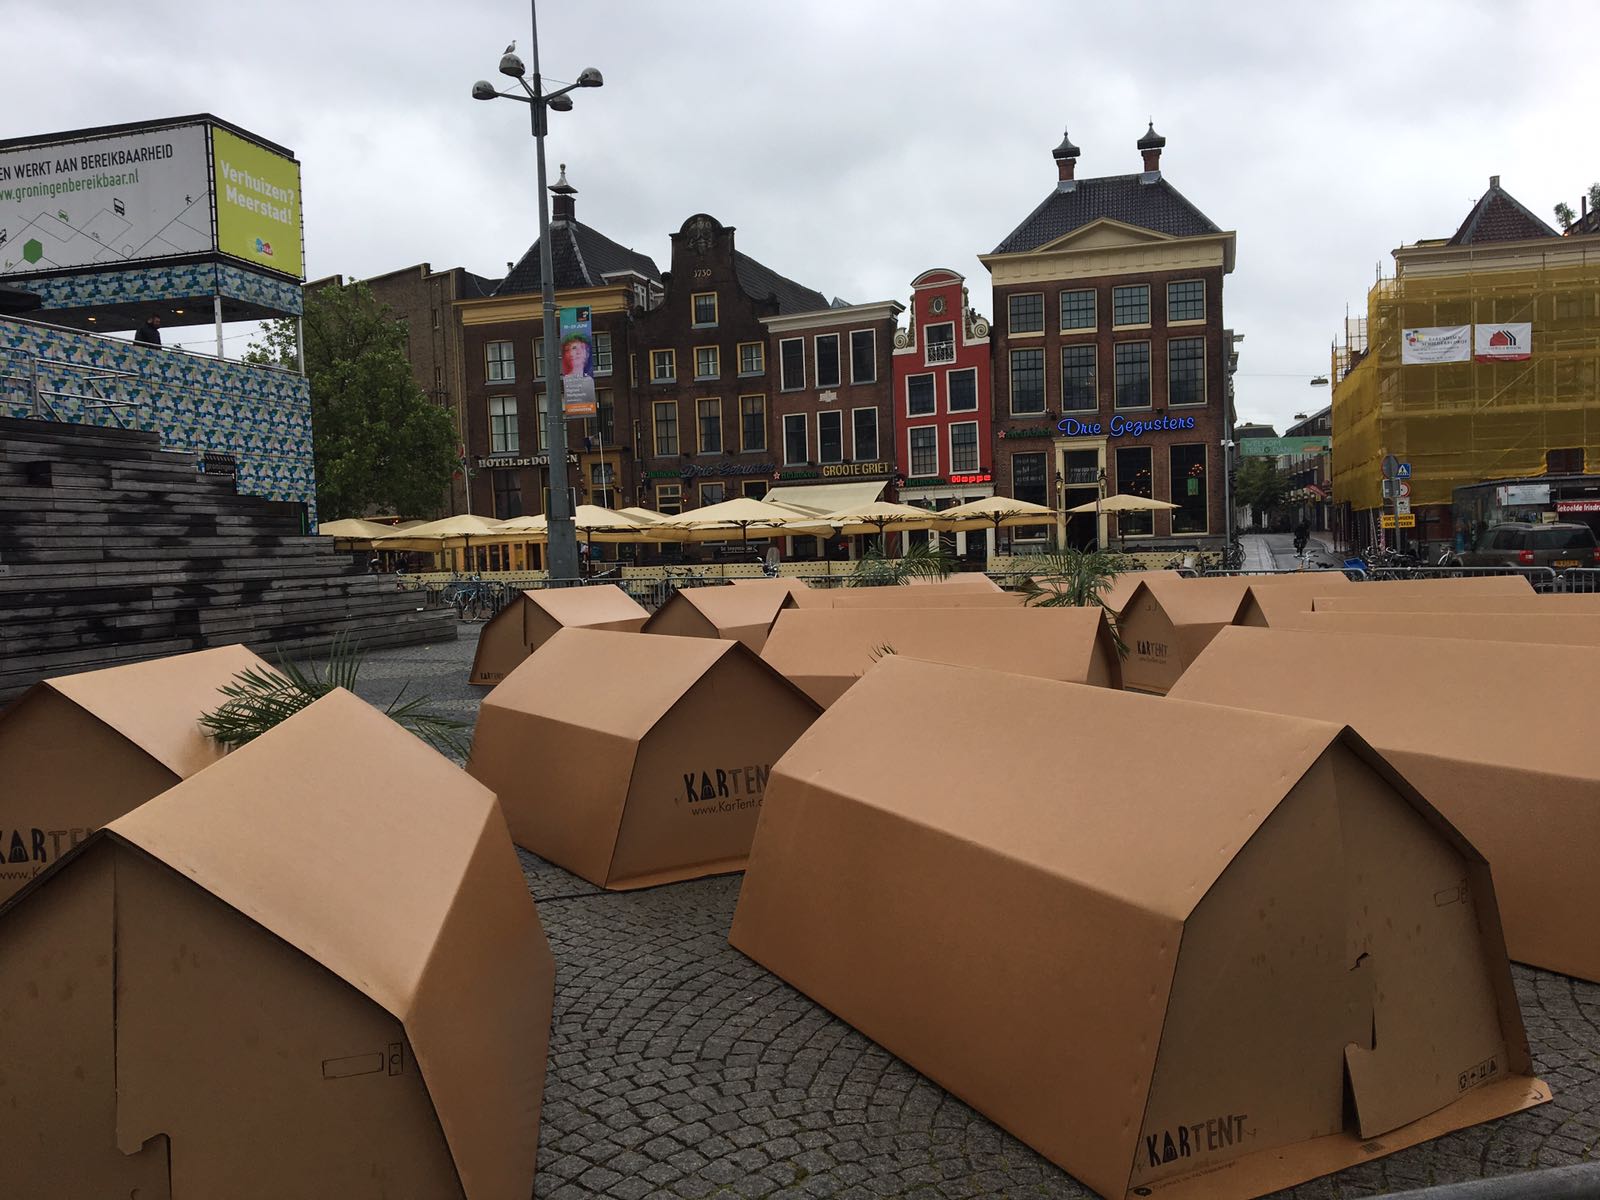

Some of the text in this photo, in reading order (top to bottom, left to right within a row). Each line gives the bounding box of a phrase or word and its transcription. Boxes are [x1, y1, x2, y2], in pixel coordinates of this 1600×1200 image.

[14, 160, 51, 179] WERKT
[55, 157, 78, 174] AAN
[81, 143, 173, 170] BEREIKBAARHEID
[220, 159, 295, 206] Verhuizen?
[225, 184, 293, 225] Meerstad!
[1057, 415, 1195, 437] Drie Gezusters
[478, 458, 516, 468] HOTEL
[517, 458, 531, 466] DE
[823, 462, 889, 477] GROOTE GRIET
[1584, 503, 1600, 511] frisdr
[1146, 1114, 1248, 1168] KARTENT
